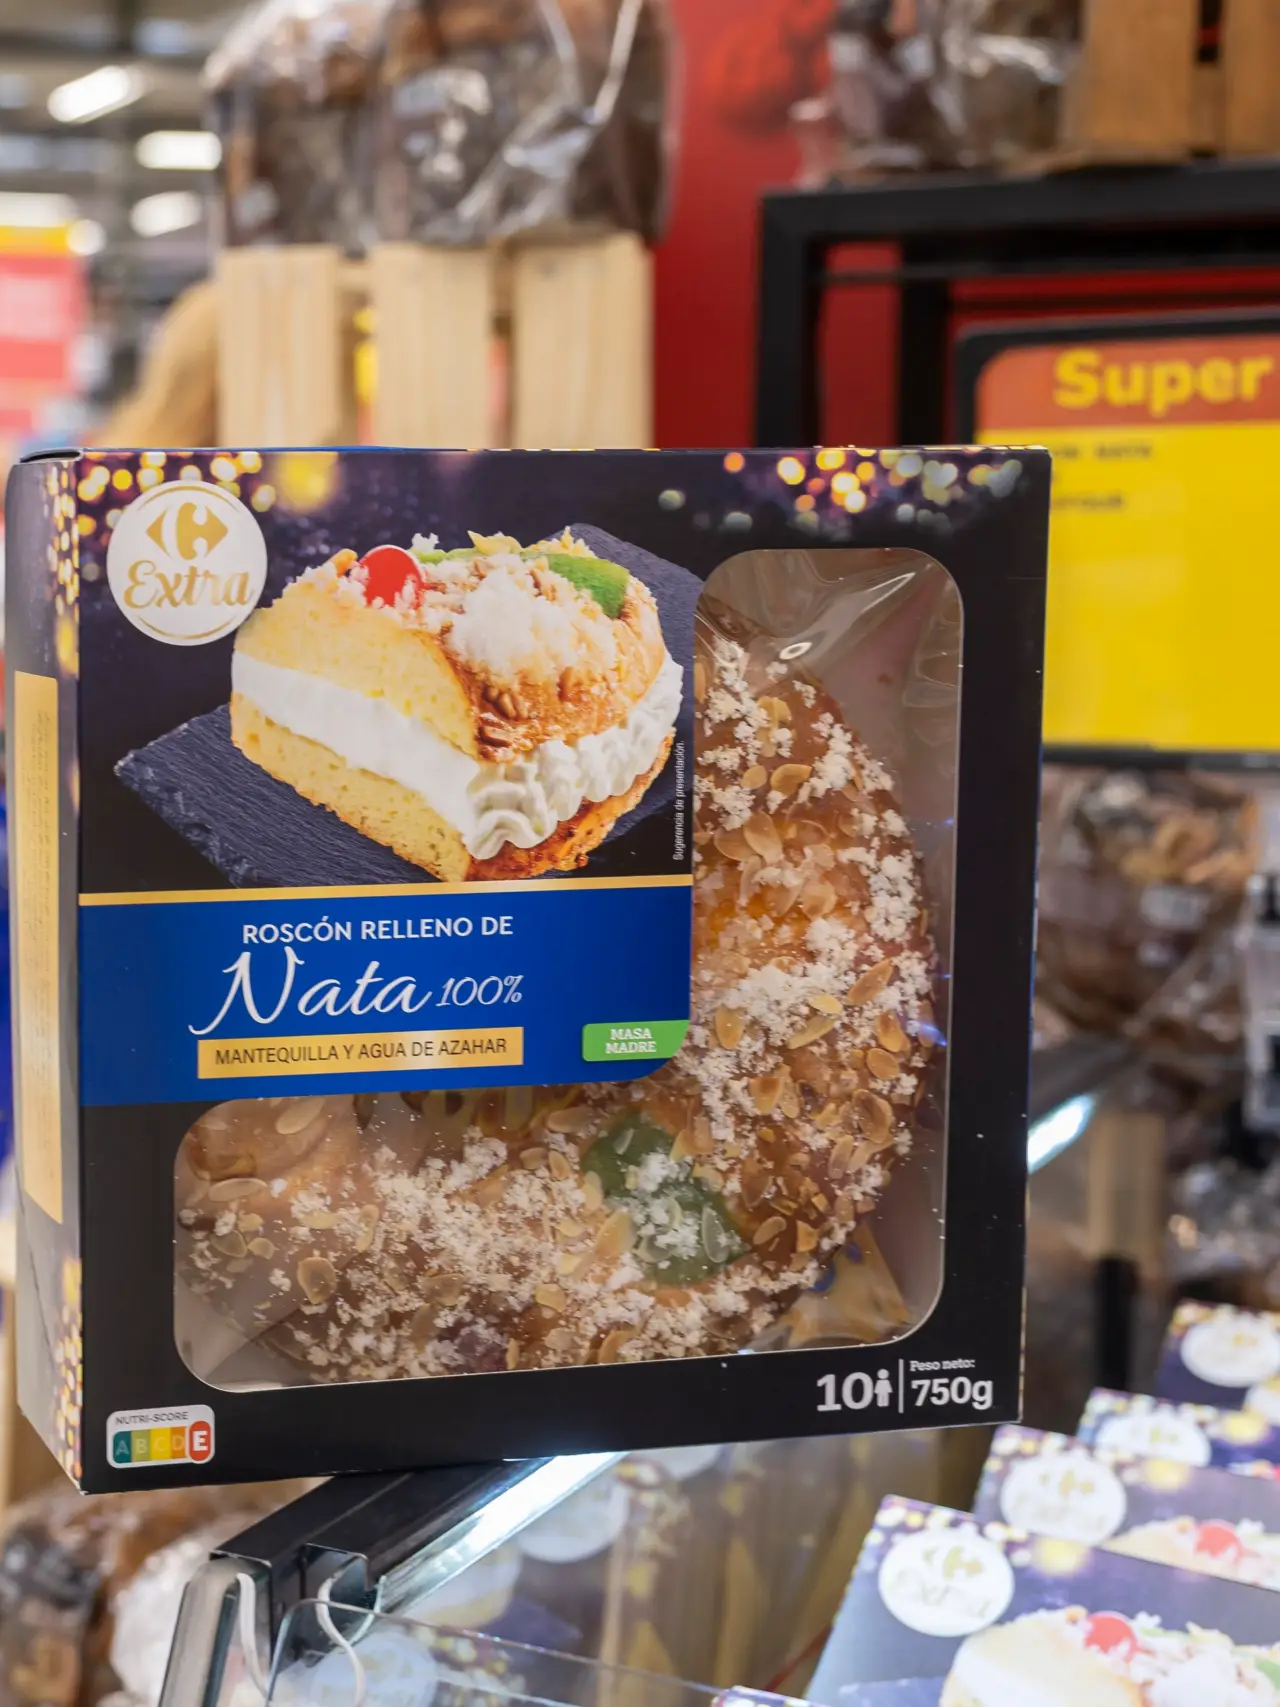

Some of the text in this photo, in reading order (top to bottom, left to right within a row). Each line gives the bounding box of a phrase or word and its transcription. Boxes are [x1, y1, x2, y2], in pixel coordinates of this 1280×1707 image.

[1053, 348, 1275, 418] Super
[123, 560, 255, 609] Extra
[672, 741, 686, 860] Sugerencia de presentación.
[242, 915, 514, 944] ROSCÓN RELLENO DE
[188, 946, 524, 1035] Nata 100%
[604, 1041, 657, 1054] MADRE
[609, 1027, 653, 1041] MASA
[215, 1038, 507, 1065] MANTEQUILLA Y AGUA DE AZAHAR
[909, 1358, 976, 1372] Peso neto:
[816, 1371, 874, 1412] 10
[911, 1376, 993, 1411] 750g
[115, 1412, 188, 1425] NUTRI-SCORE
[193, 1430, 208, 1451] E
